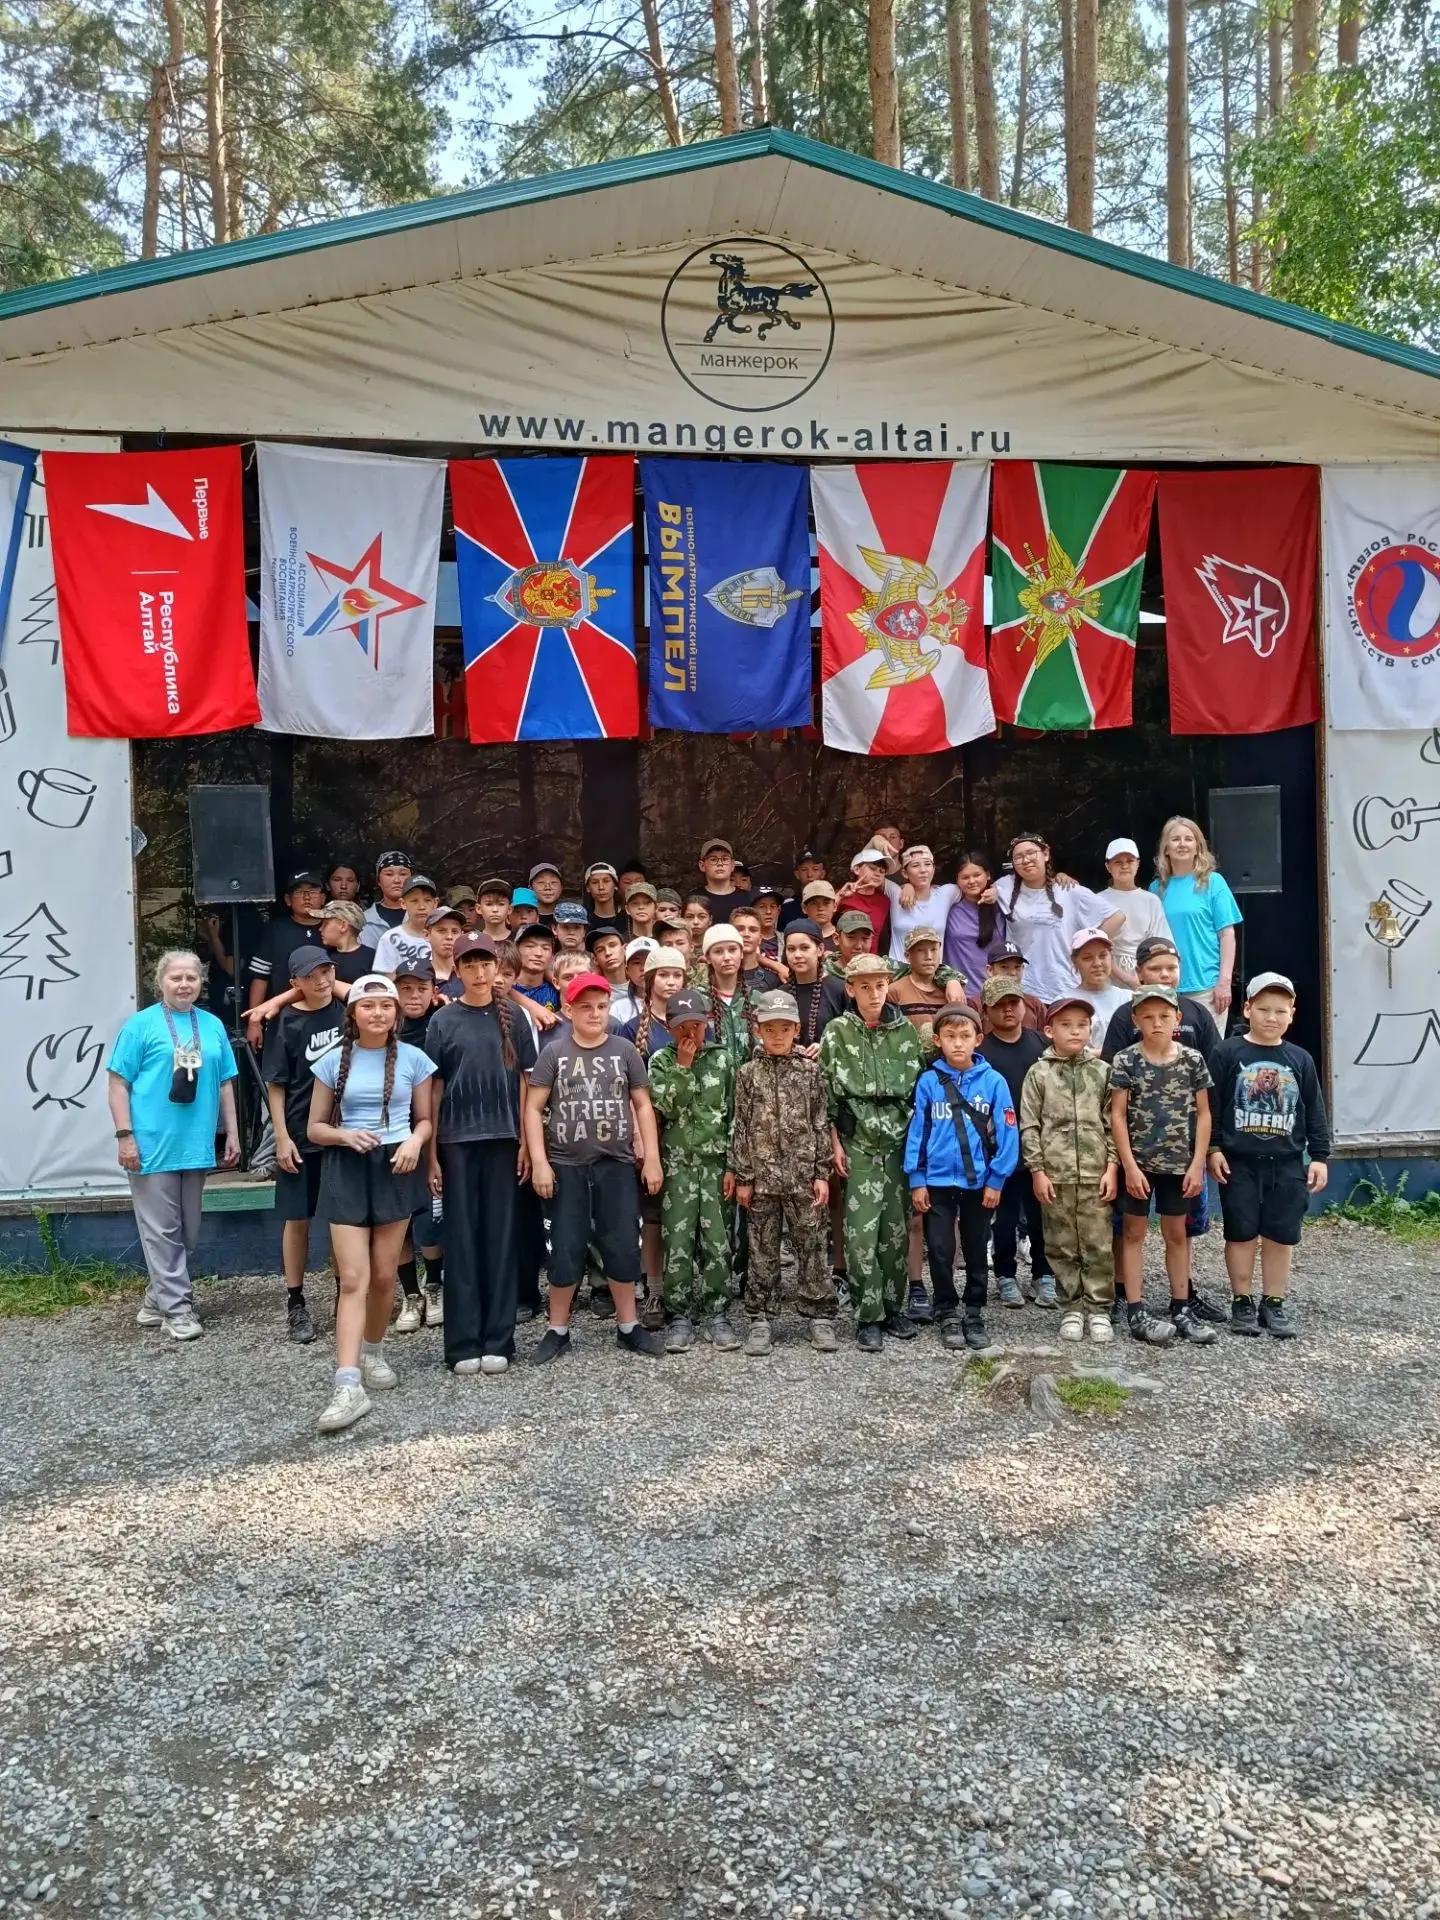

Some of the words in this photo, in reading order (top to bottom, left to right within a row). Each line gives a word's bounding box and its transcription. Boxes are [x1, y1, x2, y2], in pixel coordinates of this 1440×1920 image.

[701, 354, 799, 373] манжерок
[479, 414, 1010, 453] www.mangerok-altai.ru
[192, 477, 209, 540] Первые
[278, 558, 287, 621] ВОСПИТАНИЯ
[286, 527, 298, 657] ВОЕННО-ПАТРИОТИЧЕСКОГО
[685, 506, 698, 656] ВОЕННО-ПАТРИОТИЧЕСКИЙ
[1346, 536, 1391, 589] БОЕВЫХ
[138, 591, 160, 654] Алтай
[297, 562, 307, 628] АССОЦИАЦИЯ
[658, 501, 686, 692] ВЫМПЕЛ
[159, 591, 180, 715] Республика
[1347, 595, 1396, 668] ИСКУССТВ
[688, 656, 697, 692] ЦЕНТР
[311, 1026, 339, 1049] NIKE
[558, 1056, 621, 1079] FAST
[556, 1119, 628, 1144] RACE
[559, 1099, 625, 1121] STREET
